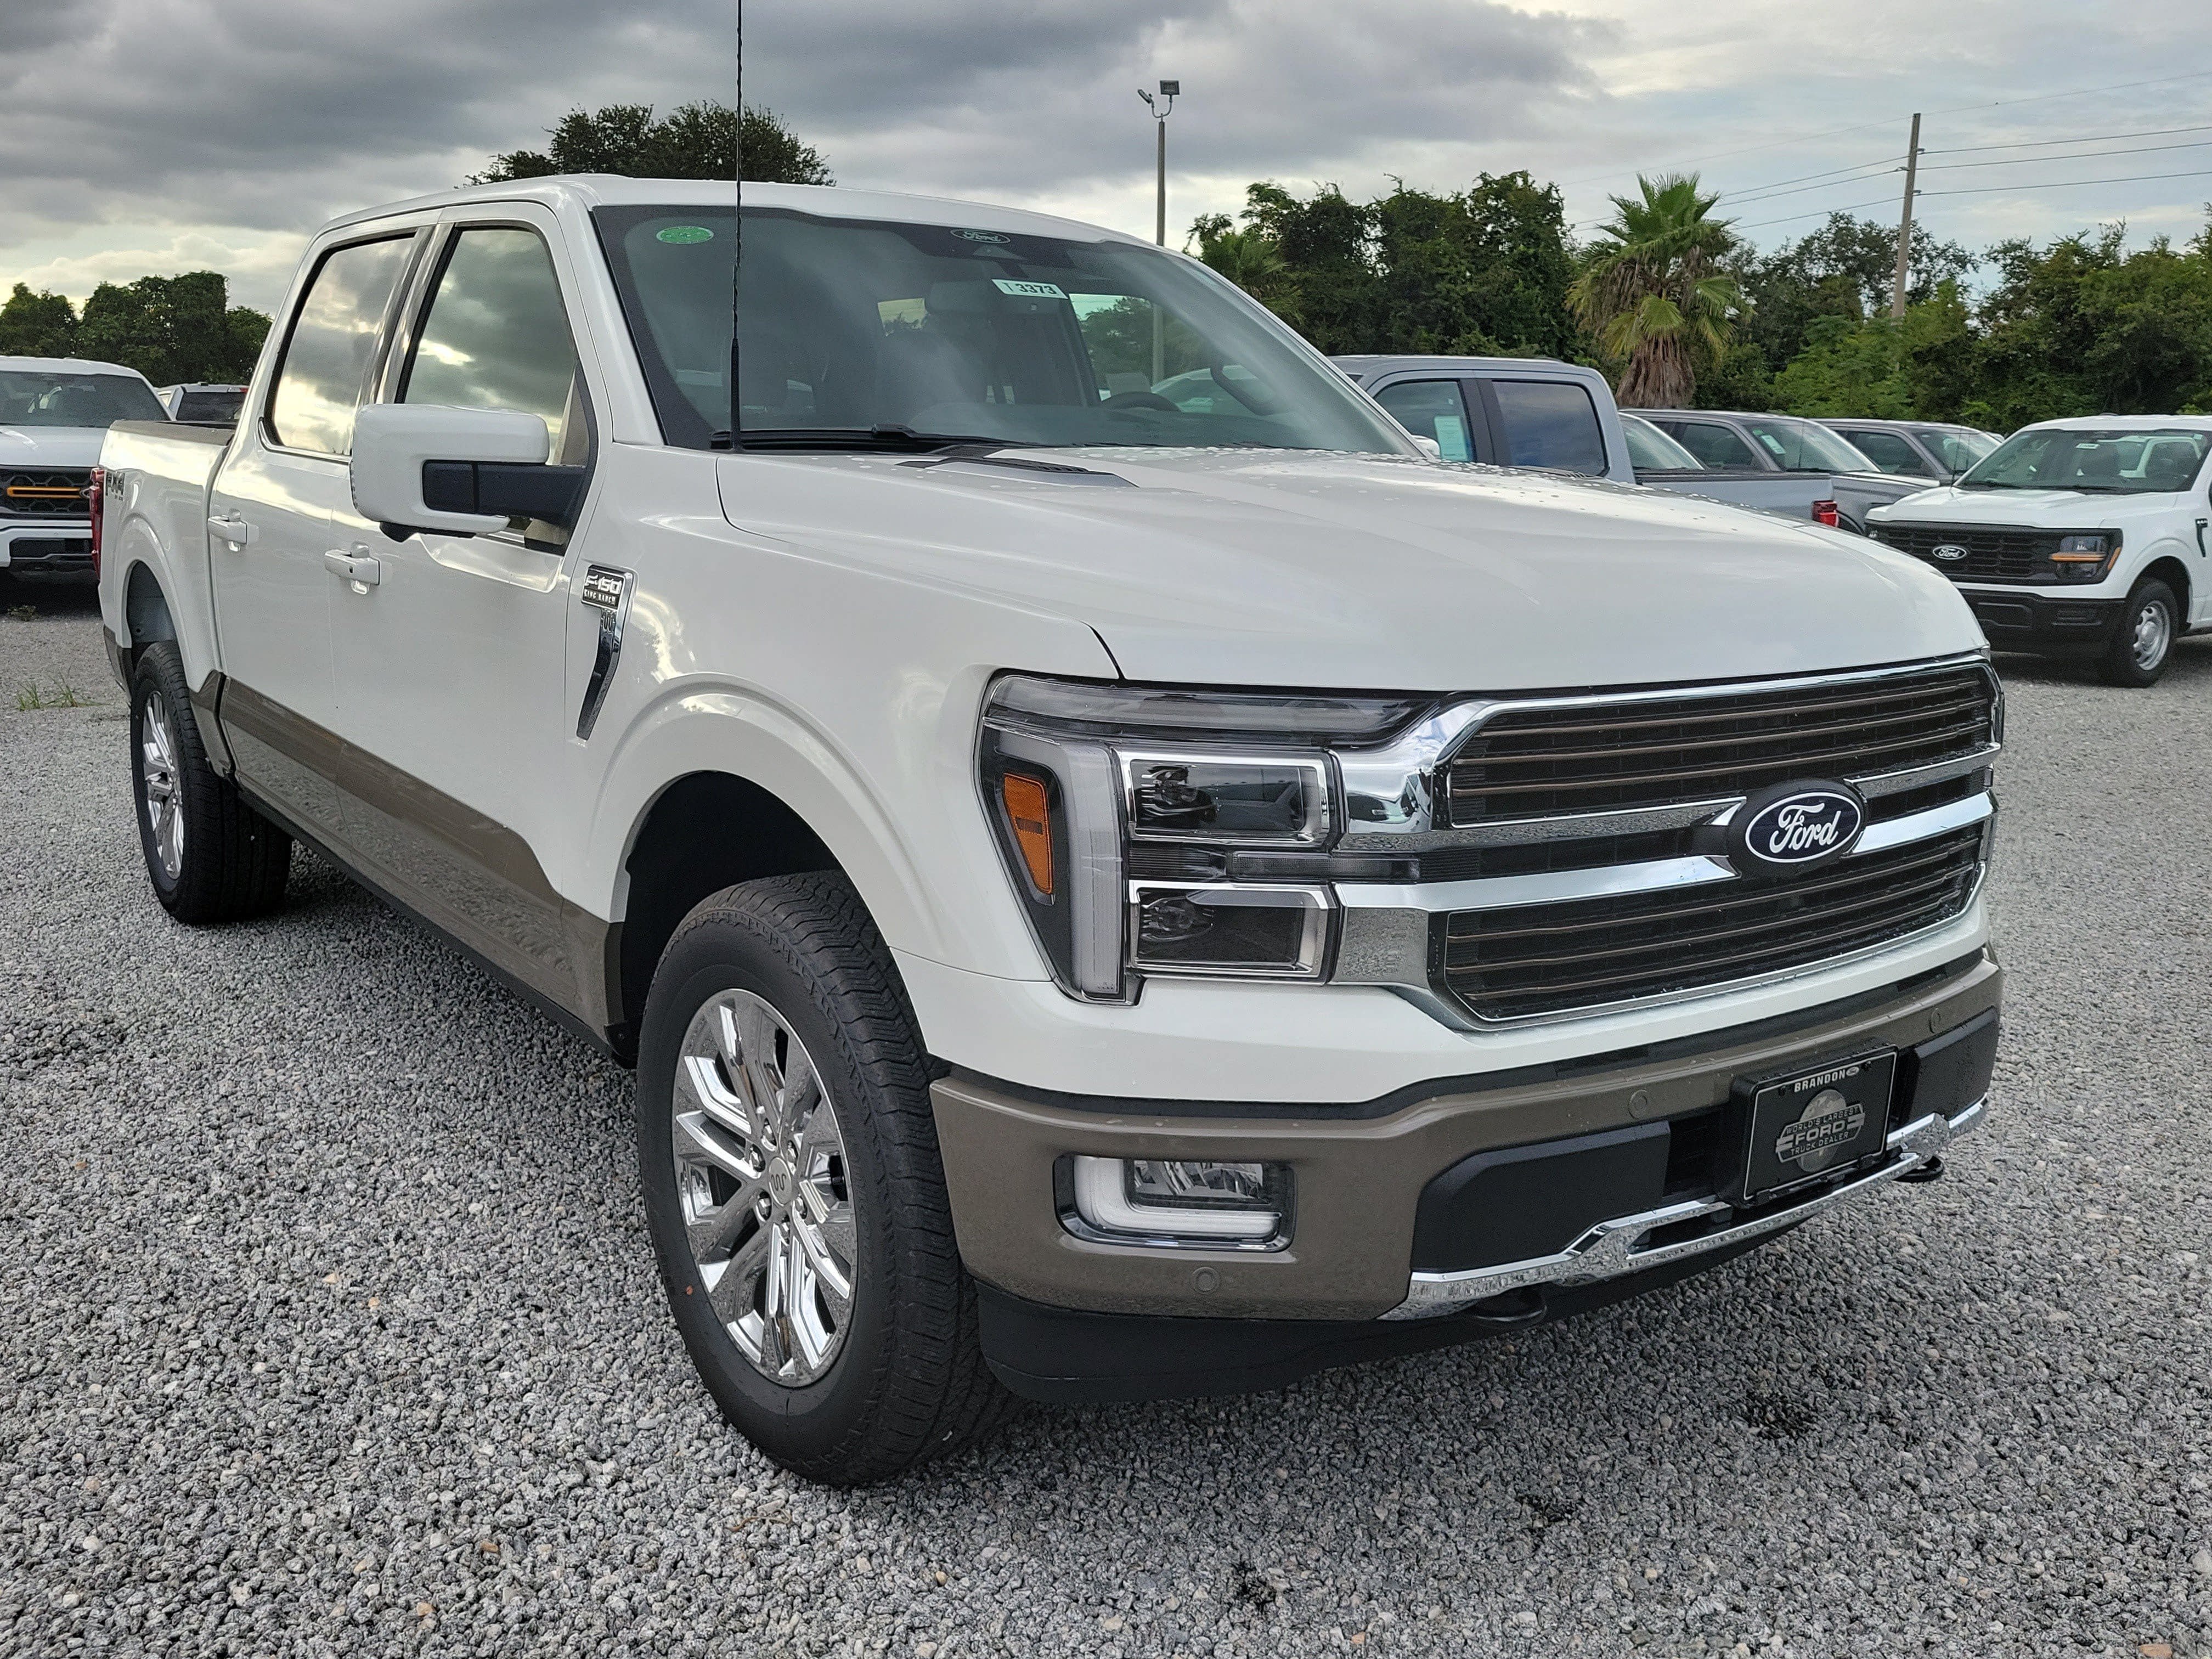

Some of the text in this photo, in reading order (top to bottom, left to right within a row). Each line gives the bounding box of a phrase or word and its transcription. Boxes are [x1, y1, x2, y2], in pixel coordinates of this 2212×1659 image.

[963, 230, 1001, 242] Ford
[1016, 284, 1057, 295] 3373
[584, 574, 623, 594] F-150
[584, 589, 616, 606] KING RANCH
[1769, 803, 1842, 854] Ford
[1794, 1069, 1846, 1093] BRANDON
[1786, 1107, 1859, 1134] WORLD'S LARGEST
[1791, 1131, 1848, 1155] TRUCK DEALER
[1795, 1120, 1846, 1146] FORD
